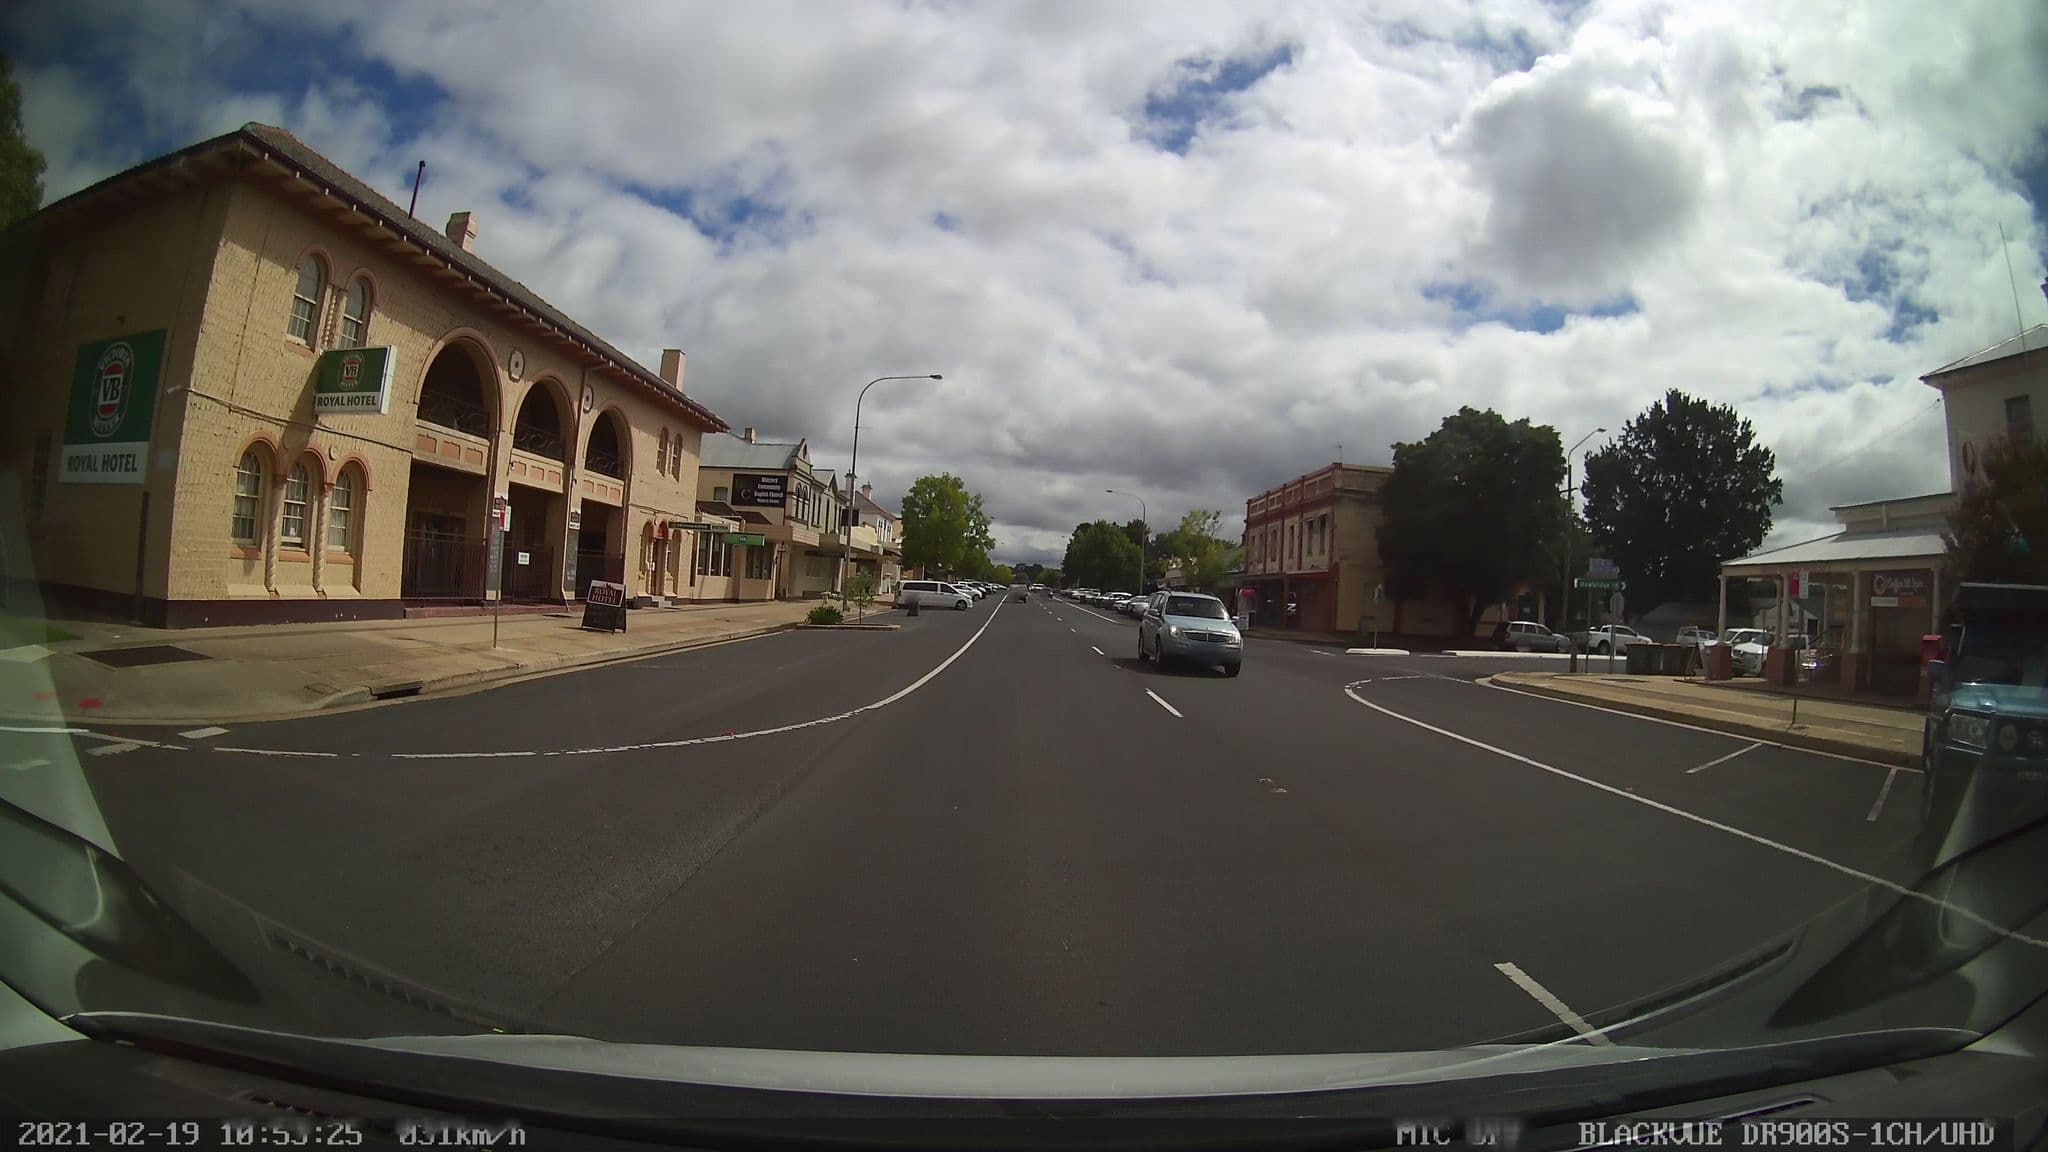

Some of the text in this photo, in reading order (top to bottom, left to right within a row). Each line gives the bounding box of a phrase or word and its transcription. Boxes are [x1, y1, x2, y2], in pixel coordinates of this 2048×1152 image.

[346, 366, 357, 376] VB
[102, 378, 121, 401] VB
[317, 395, 377, 407] ROYAL HOTEL
[67, 453, 138, 473] ROYAL HOTEL
[594, 587, 617, 597] ROYAL
